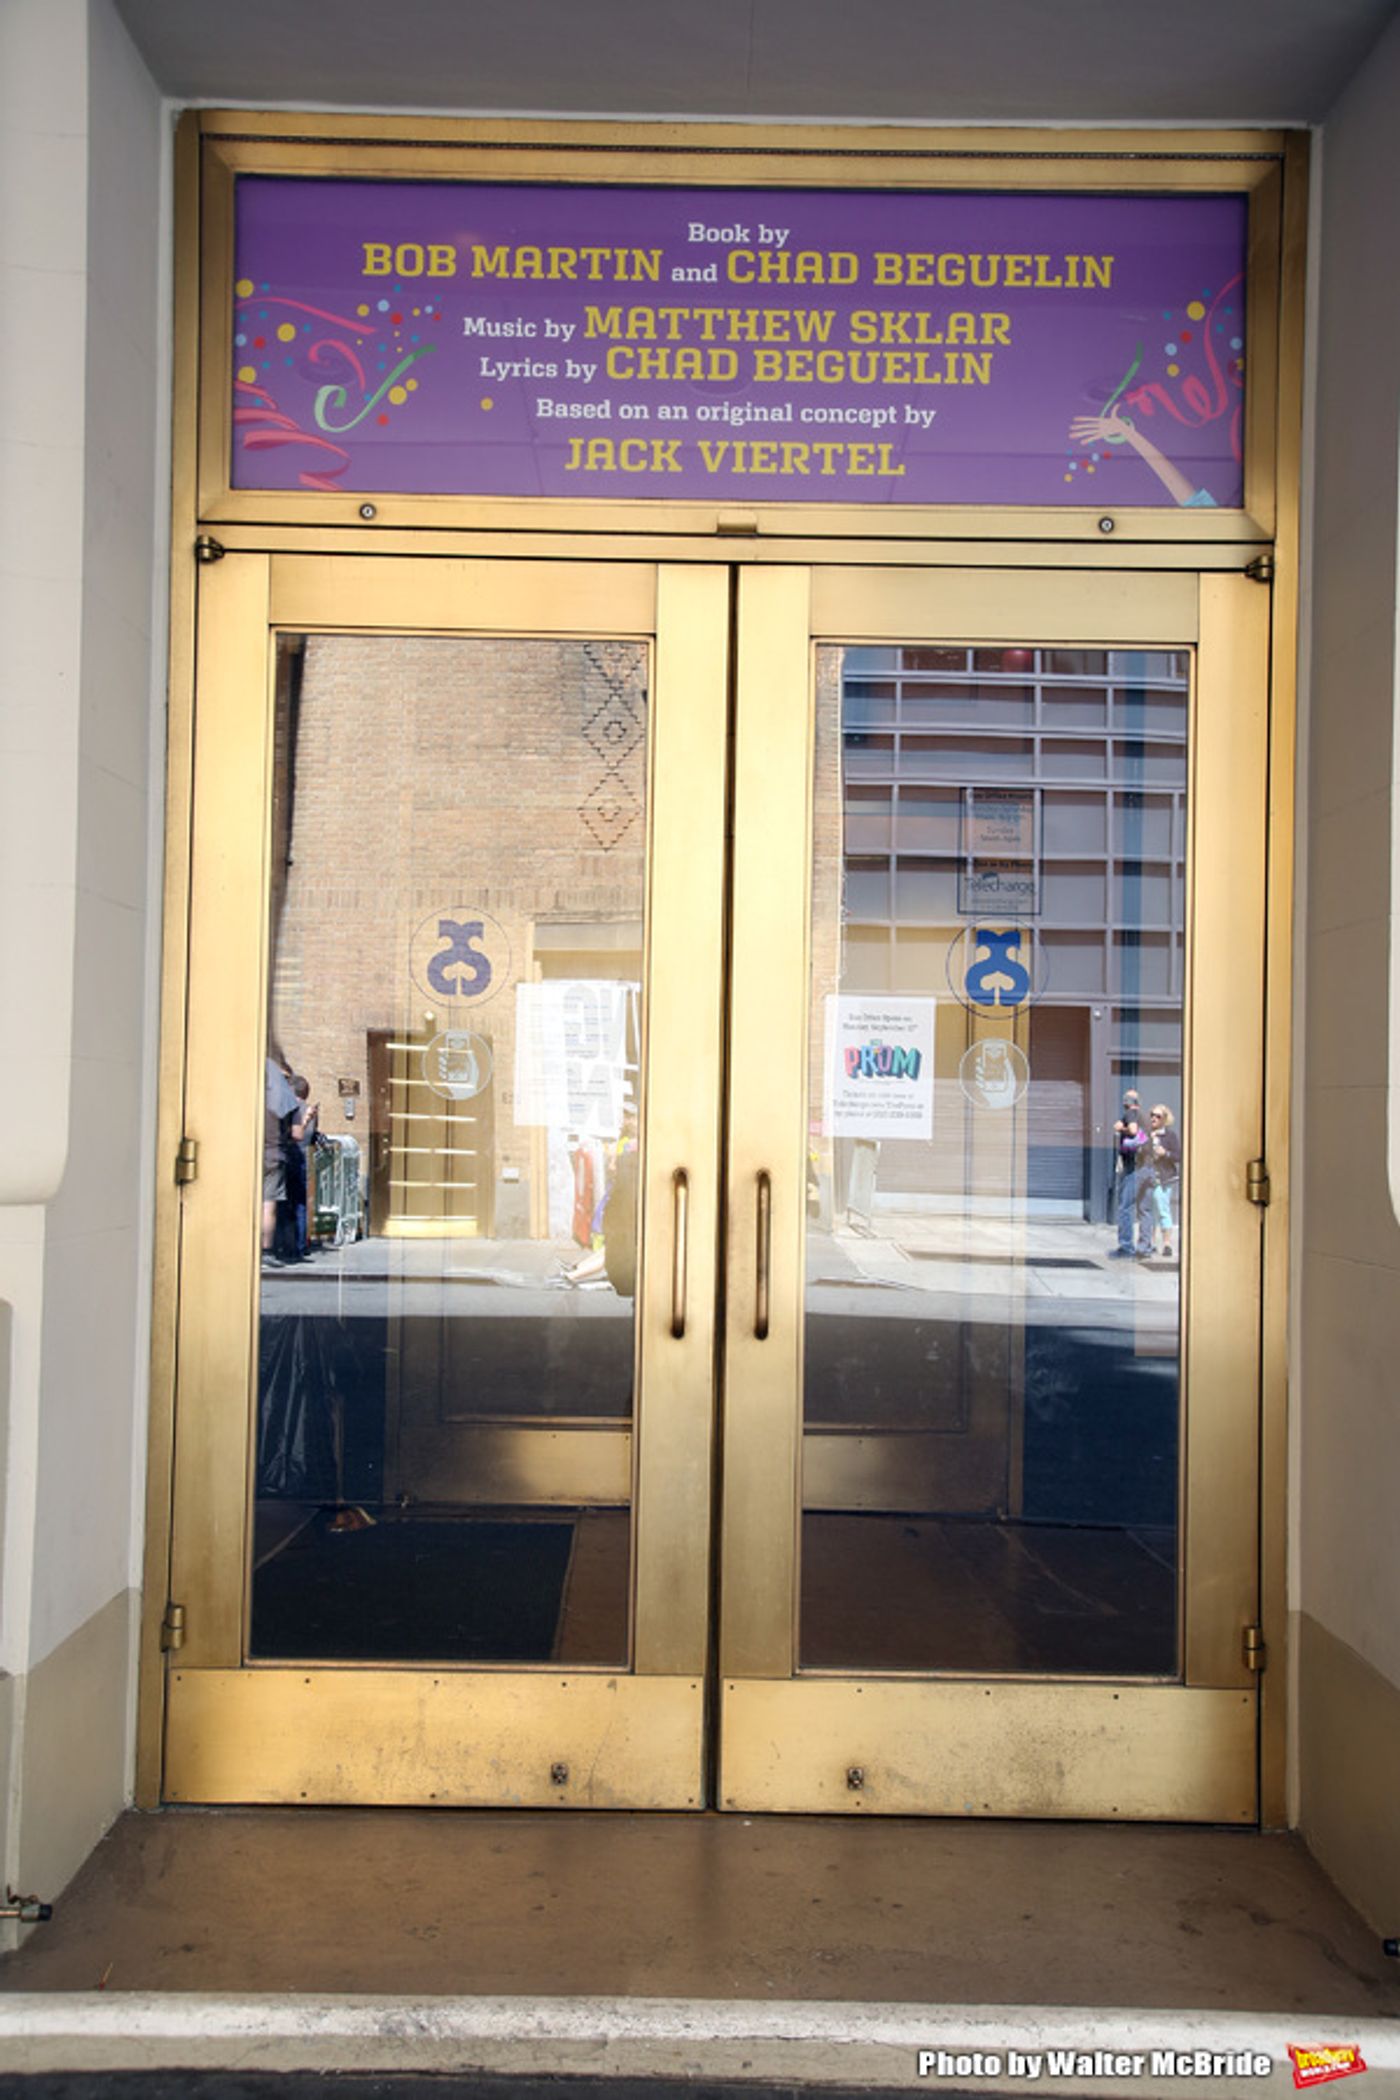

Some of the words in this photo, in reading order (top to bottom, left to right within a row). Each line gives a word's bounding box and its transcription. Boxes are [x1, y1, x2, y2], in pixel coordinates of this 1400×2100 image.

[688, 223, 750, 243] Book
[758, 224, 790, 248] by
[363, 243, 456, 277] BOB
[471, 245, 663, 281] MARTIN
[671, 263, 718, 282] and
[727, 249, 859, 285] CHAD
[874, 252, 1114, 288] BEGUELIN
[463, 317, 537, 338] Music
[544, 318, 576, 343] by
[585, 306, 836, 342] MATTHEW
[850, 310, 1011, 345] SKLAR
[480, 356, 558, 382] Lyrics
[565, 358, 598, 384] by
[606, 345, 738, 381] CHAD
[753, 349, 993, 385] BEGUELIN
[536, 397, 612, 420] Based
[618, 403, 651, 420] on
[657, 405, 690, 421] an
[695, 400, 793, 427] original
[799, 405, 898, 429] concept
[904, 404, 937, 429] by
[565, 437, 682, 472] JACK
[698, 440, 905, 475] VIERTEL
